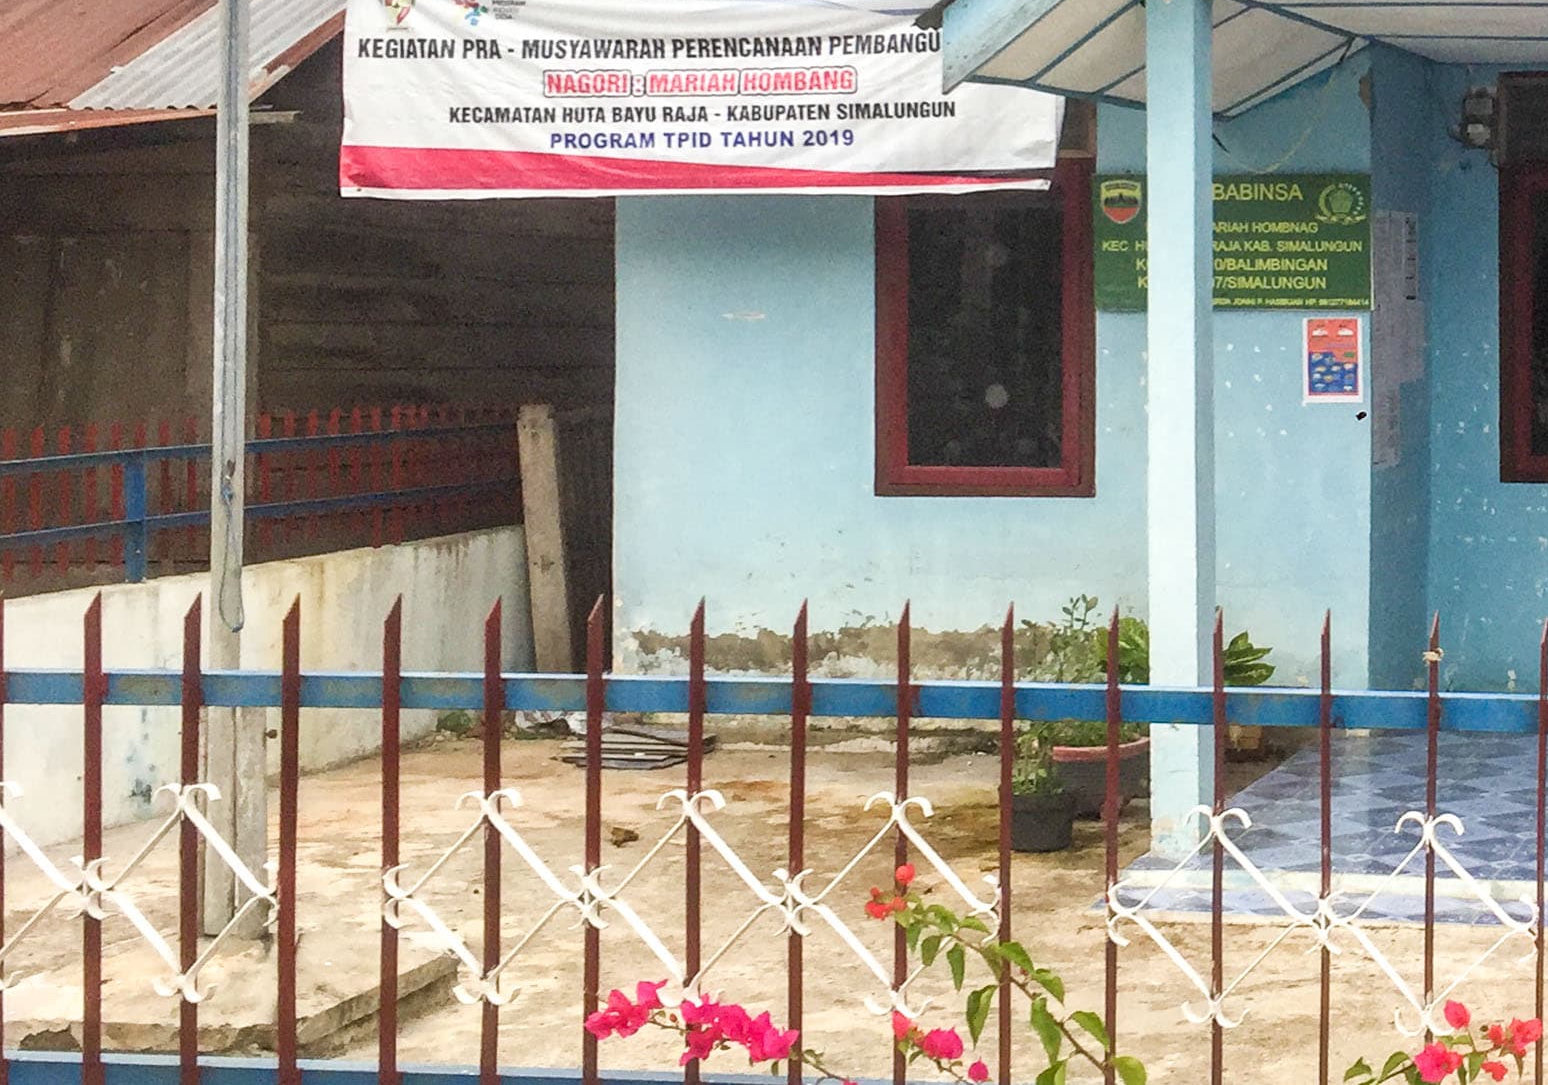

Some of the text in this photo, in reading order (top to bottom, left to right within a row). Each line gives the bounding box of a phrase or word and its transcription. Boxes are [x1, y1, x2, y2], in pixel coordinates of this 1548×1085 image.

[357, 38, 456, 60] KEGIATAN
[462, 39, 502, 60] PRA
[521, 38, 666, 60] MUSYAWARAH
[672, 35, 822, 59] PERENCANAAN
[828, 31, 941, 56] PEMBANGU
[545, 73, 630, 94] NAGORI
[648, 71, 738, 93] MARIAH
[741, 69, 854, 93] HOMBANG
[449, 106, 556, 124] KECAMATAN
[562, 106, 606, 123] HUTA
[612, 105, 656, 123] BAYU
[662, 105, 709, 123] RAJA
[726, 103, 831, 122] KABUPATEN
[836, 101, 957, 121] SIMALUNGUN
[550, 129, 855, 149] PROGRAM TPID TAHUN 2019
[1212, 183, 1304, 201] BABINSA
[1212, 221, 1319, 234] ARIAH HOMBNAG
[1102, 240, 1130, 252] KEC
[1276, 240, 1363, 253] SIMALUNGUN
[1213, 258, 1328, 272] 0/BALIMBINGAN
[1212, 276, 1327, 290] 7/SIMALUNGUN
